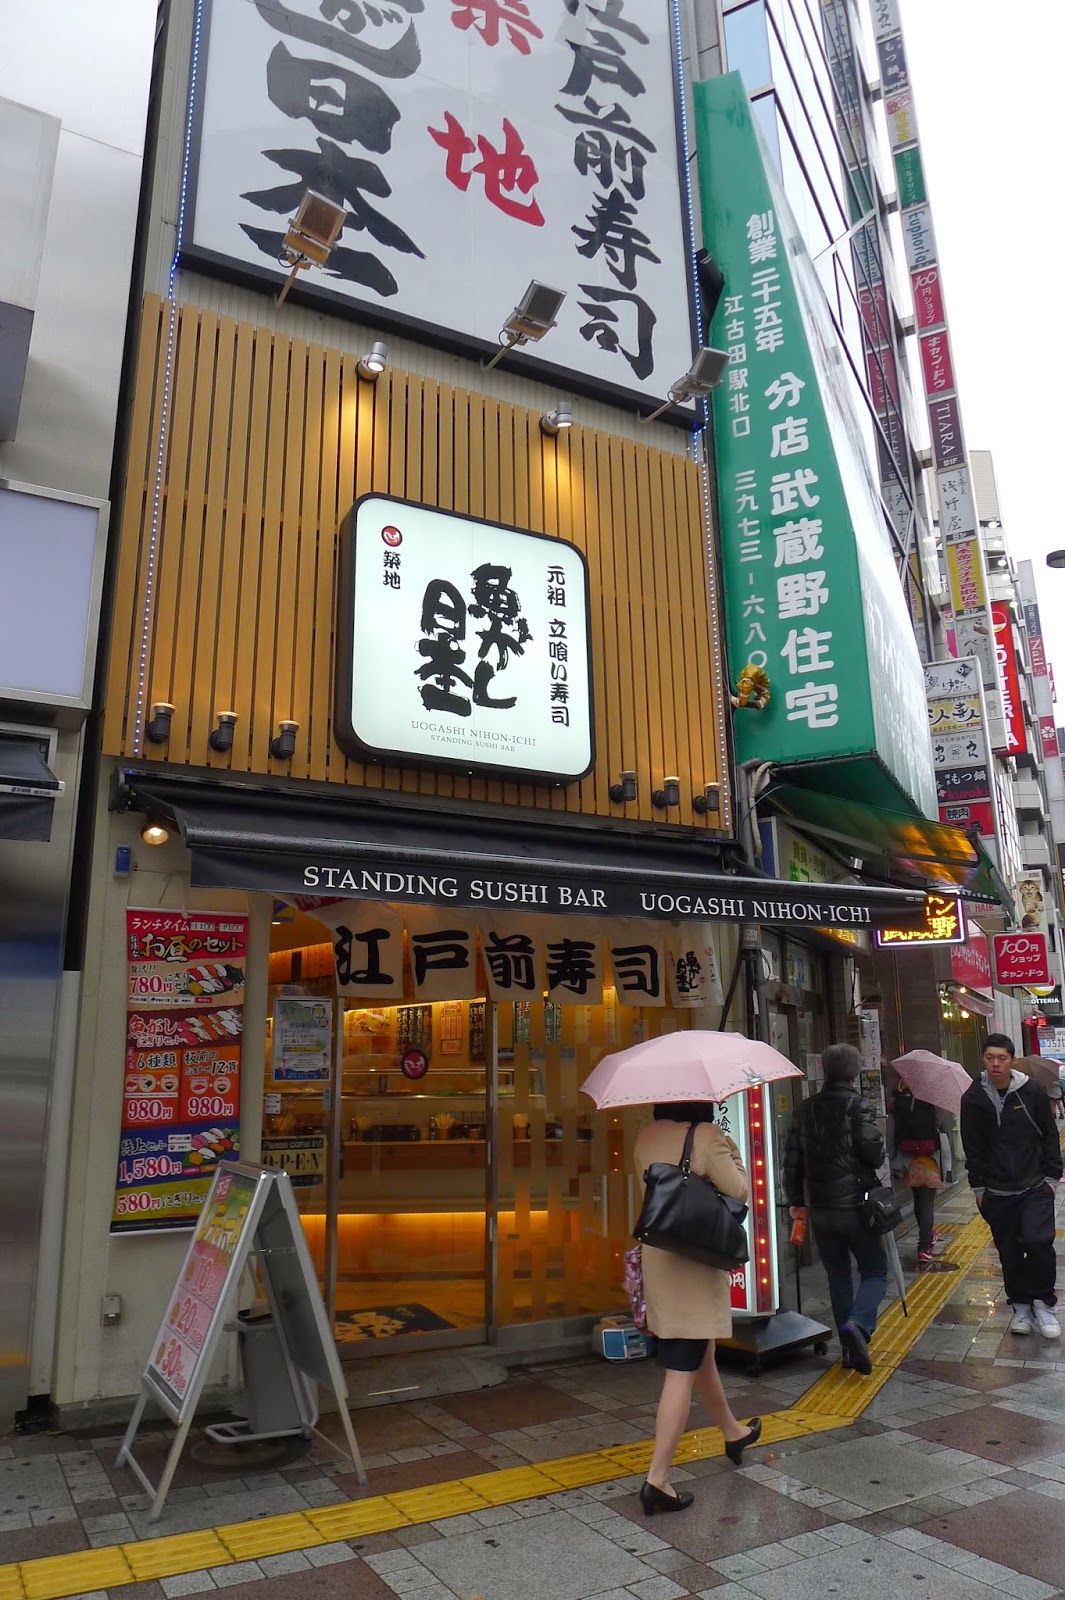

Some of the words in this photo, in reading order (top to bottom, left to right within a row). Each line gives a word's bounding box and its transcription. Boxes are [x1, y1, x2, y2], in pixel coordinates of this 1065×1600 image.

[906, 210, 930, 264] Euphoria
[936, 403, 955, 456] TIARA
[943, 458, 958, 467] B1F
[764, 371, 839, 729] 分店武蔵野住宅
[382, 550, 401, 589] 築地
[547, 565, 566, 607] 元祖
[1031, 639, 1044, 666] Nail
[549, 618, 570, 728] 立喰い寿司
[411, 720, 466, 736] UOGASHI
[470, 730, 536, 746] NIHON-ICHI
[431, 735, 472, 746] STANDING
[475, 740, 498, 749] SUSHI
[500, 744, 515, 752] BAR
[952, 771, 986, 785] もつ鍋
[304, 866, 458, 897] STANDING
[470, 880, 548, 904] SUSHI
[558, 886, 607, 908] BAR
[640, 892, 745, 917] UOGASHI
[752, 901, 872, 923] NIHON-ICHI
[132, 918, 190, 932] ランチタイム
[140, 932, 244, 962] お昼のセット
[999, 939, 1039, 957] 100円
[1011, 954, 1041, 963] ショップ
[335, 925, 659, 998] 江戸前寿司
[130, 975, 172, 994] 780円
[129, 1015, 178, 1039] 魚がし
[136, 1052, 177, 1070] 6種類
[184, 1051, 219, 1066] 板前の
[128, 1100, 173, 1120] 980円
[188, 1097, 234, 1116] 980円
[263, 1141, 289, 1149] Please
[290, 1140, 311, 1148] come
[119, 1155, 182, 1184] 1,580円
[117, 1192, 162, 1214] 580円
